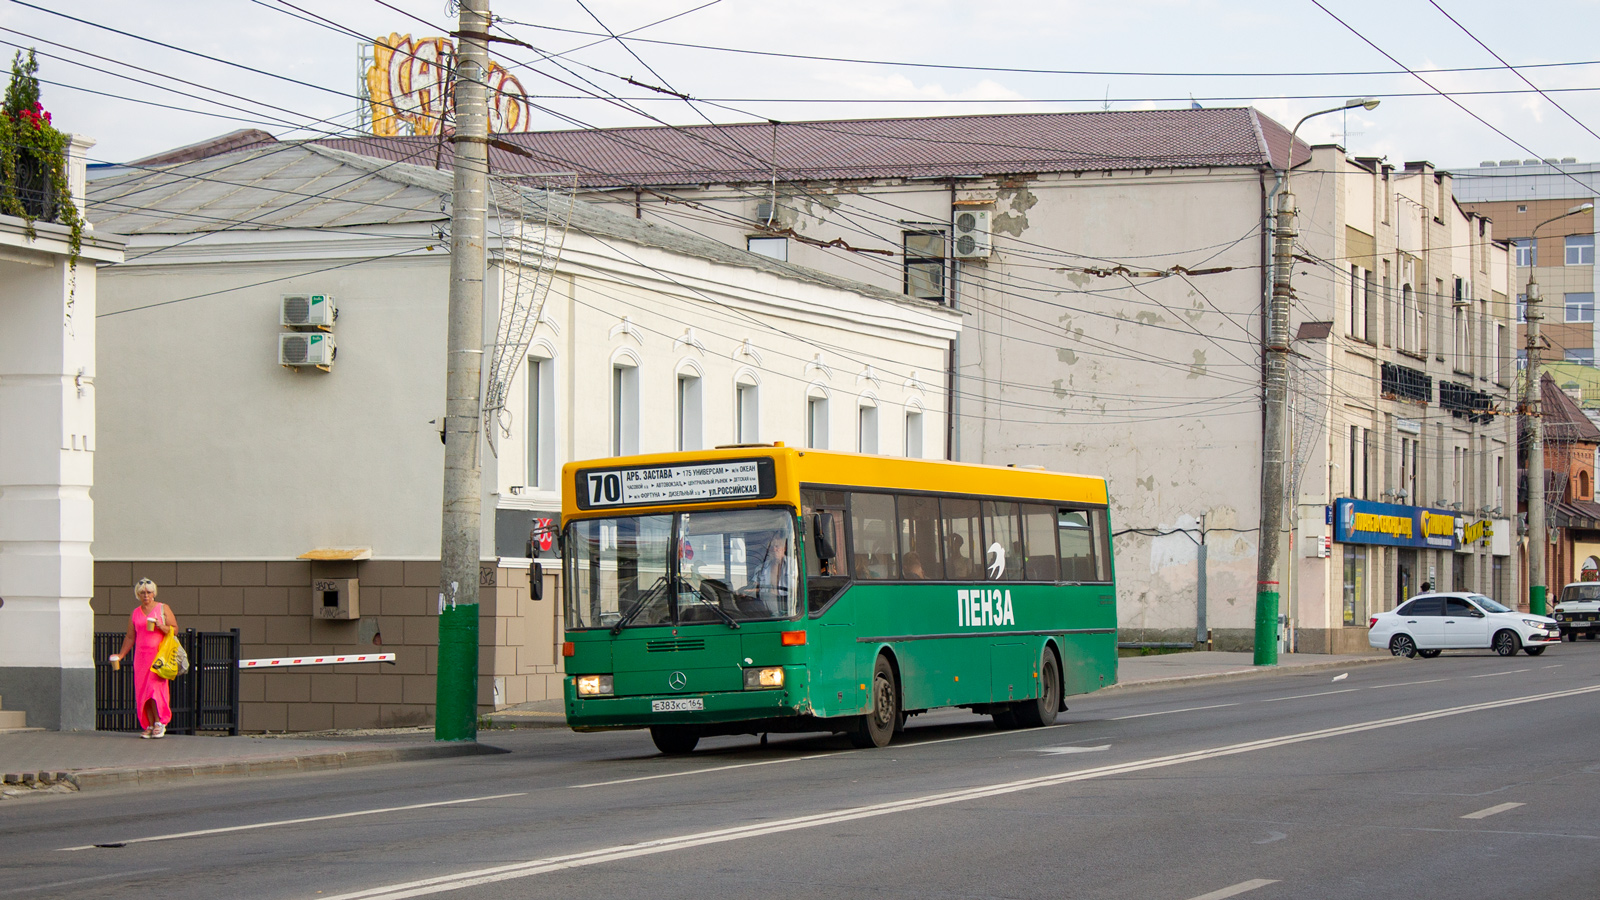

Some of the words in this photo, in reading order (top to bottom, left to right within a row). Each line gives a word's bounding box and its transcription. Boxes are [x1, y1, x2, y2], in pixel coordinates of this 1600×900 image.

[627, 471, 641, 481] АРБ.
[643, 469, 672, 480] ЗАСТАВА
[693, 467, 724, 476] УНИВЕРСАМ
[688, 478, 714, 486] ЦЕНТРАЛЬНЫЙ
[590, 474, 620, 503] 70
[668, 489, 694, 497] ДИЗЕЛЬНЫЙ
[957, 589, 1015, 626] ПЕНЗА
[655, 701, 687, 710] Е383КС
[688, 699, 702, 707] 164
